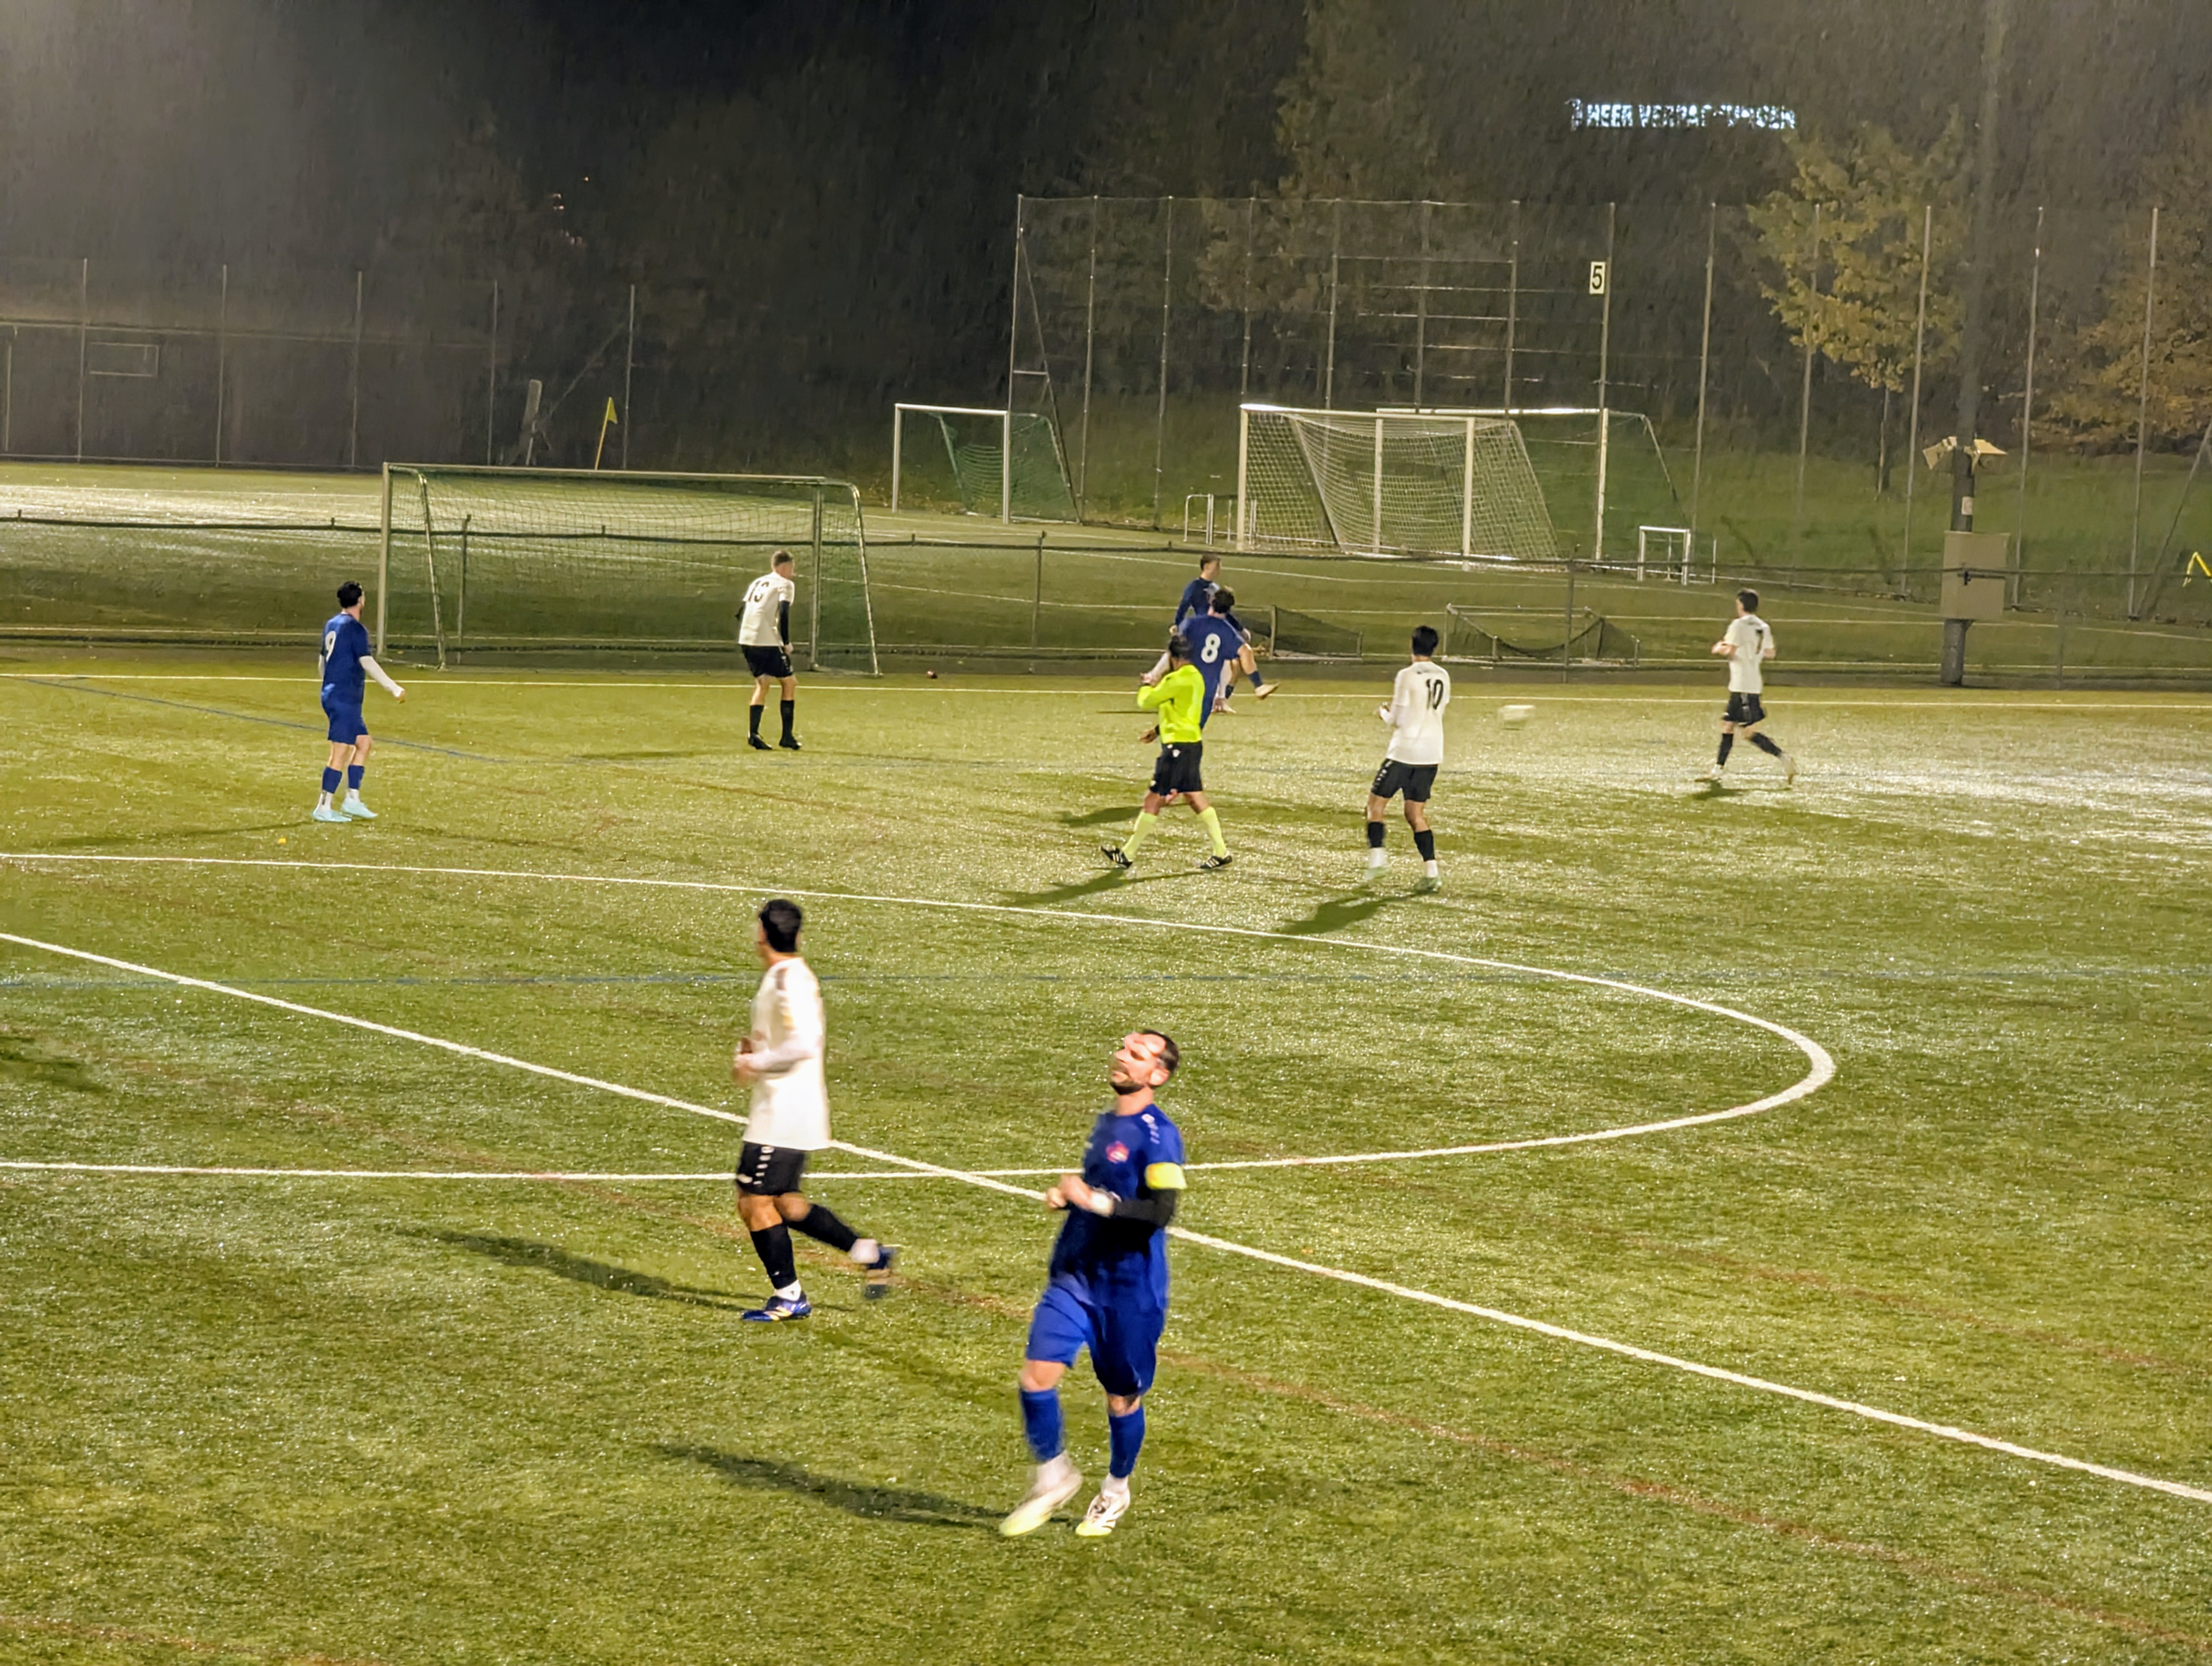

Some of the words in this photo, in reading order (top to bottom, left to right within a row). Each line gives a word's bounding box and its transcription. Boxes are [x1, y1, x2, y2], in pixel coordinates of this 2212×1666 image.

[1592, 265, 1603, 290] 5
[325, 630, 337, 661] 9
[1200, 633, 1221, 663] 8
[1755, 629, 1764, 655] 7
[1425, 678, 1443, 710] 10
